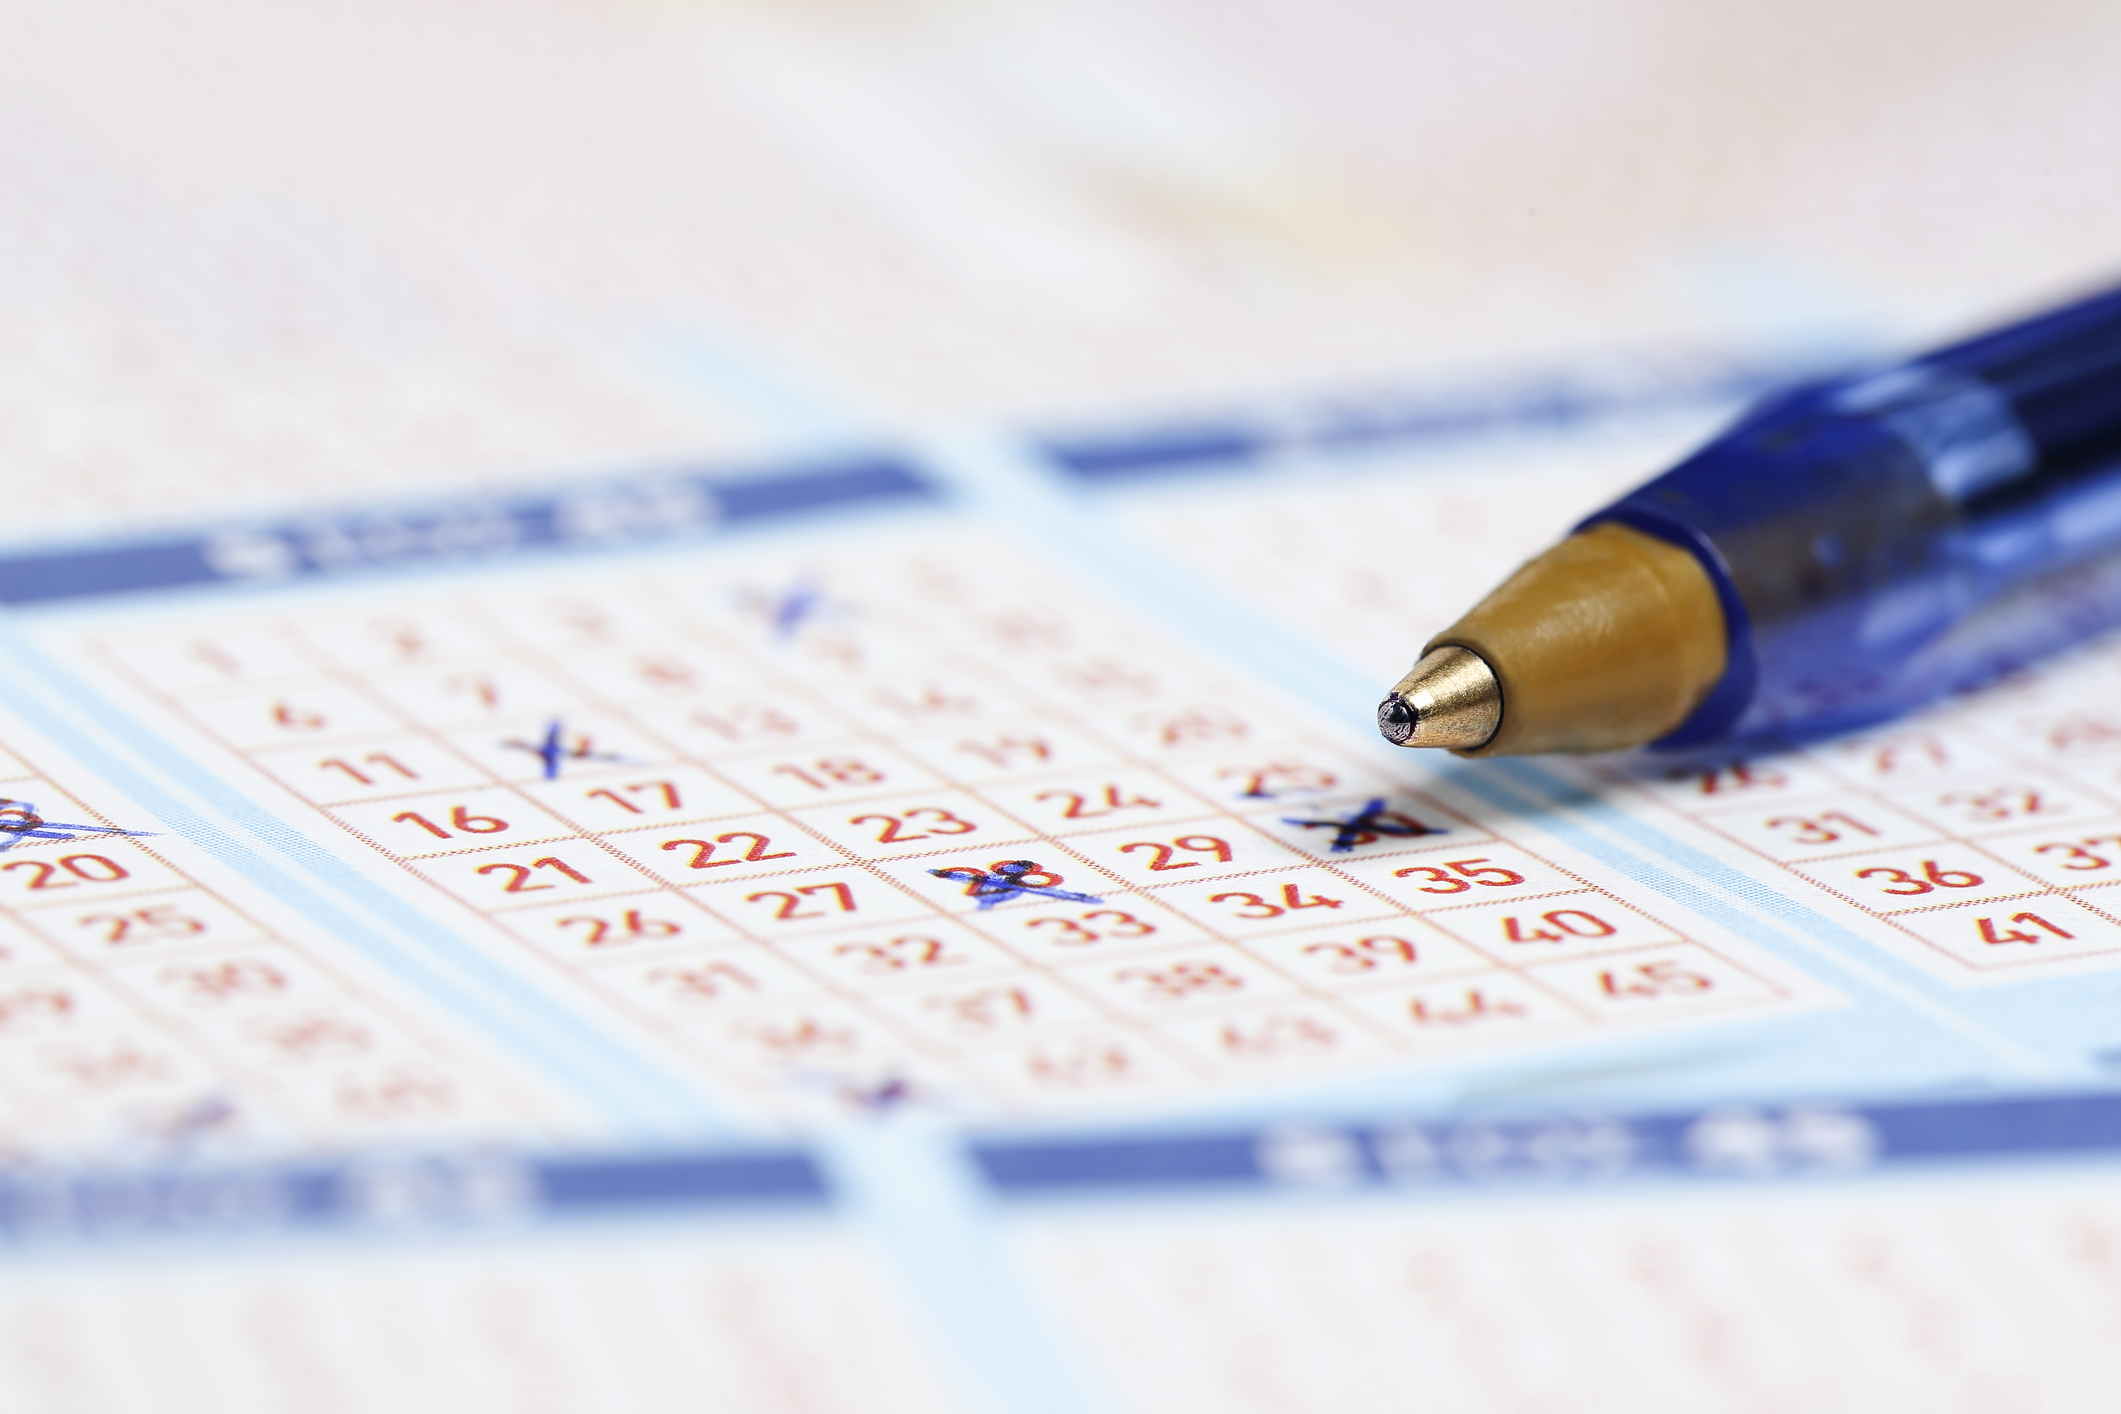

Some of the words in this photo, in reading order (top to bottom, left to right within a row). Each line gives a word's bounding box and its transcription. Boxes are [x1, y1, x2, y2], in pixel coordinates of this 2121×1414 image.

[321, 753, 419, 785] 11
[394, 806, 509, 839] 16
[589, 782, 682, 814] 17
[775, 760, 885, 790] 18
[477, 857, 591, 893] 21
[662, 832, 796, 869] 22
[851, 810, 976, 844] 23
[1037, 786, 1160, 819] 24
[1767, 812, 1878, 844] 31
[3, 854, 129, 890] 20
[559, 910, 681, 945] 26
[747, 883, 856, 920] 27
[934, 859, 1065, 898] 28
[1120, 836, 1232, 871] 29
[1857, 861, 1984, 895] 36
[76, 905, 207, 944] 25
[644, 959, 762, 1003] 31
[836, 934, 967, 973] 32
[1028, 911, 1157, 943] 33
[1210, 884, 1343, 918] 34
[1395, 859, 1525, 894] 35
[1302, 934, 1418, 976] 39
[1504, 910, 1617, 943] 40
[1977, 912, 2074, 945] 41
[1600, 965, 1712, 997] 45
